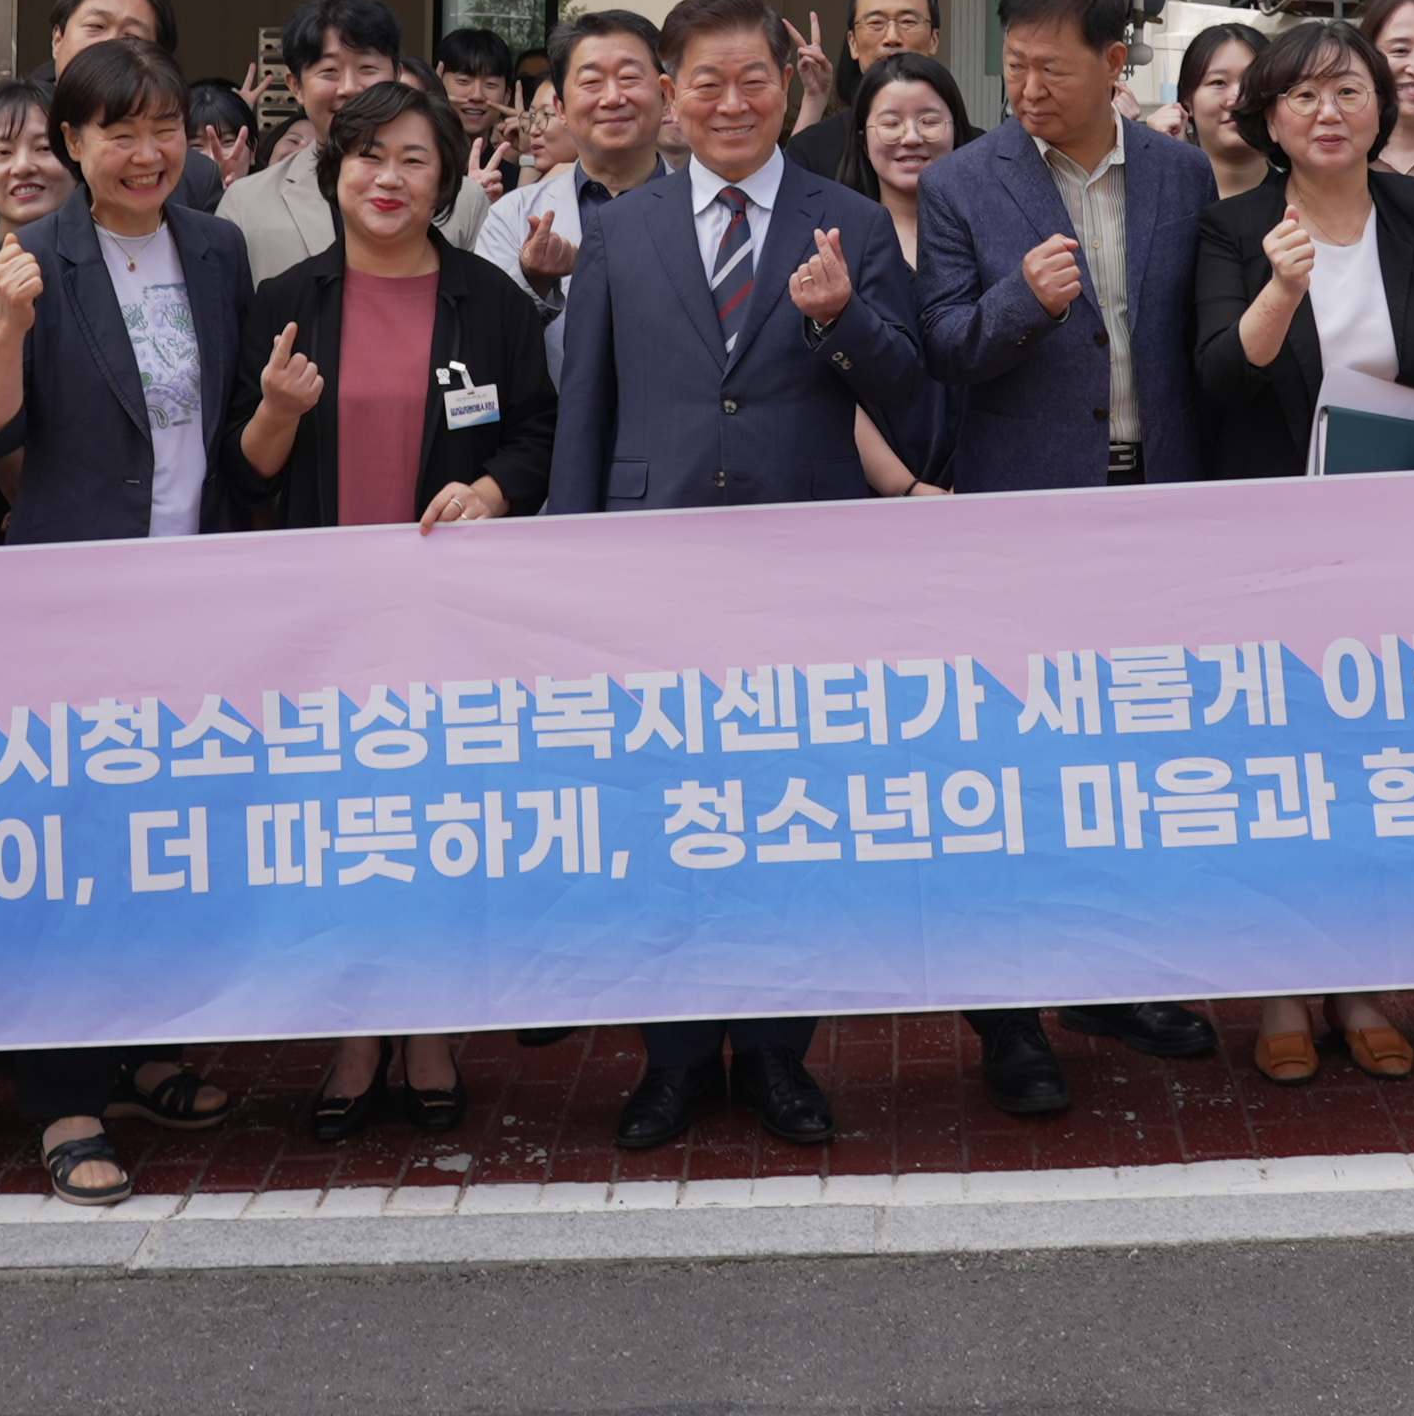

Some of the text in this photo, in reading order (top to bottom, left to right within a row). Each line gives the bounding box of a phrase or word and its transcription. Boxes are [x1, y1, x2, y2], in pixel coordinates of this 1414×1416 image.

[1017, 639, 1289, 738] 새롭게
[130, 809, 212, 894] 더
[245, 784, 630, 887] 따뜻하게,
[661, 768, 1025, 870] 청소년의
[1061, 751, 1336, 852] 마음과
